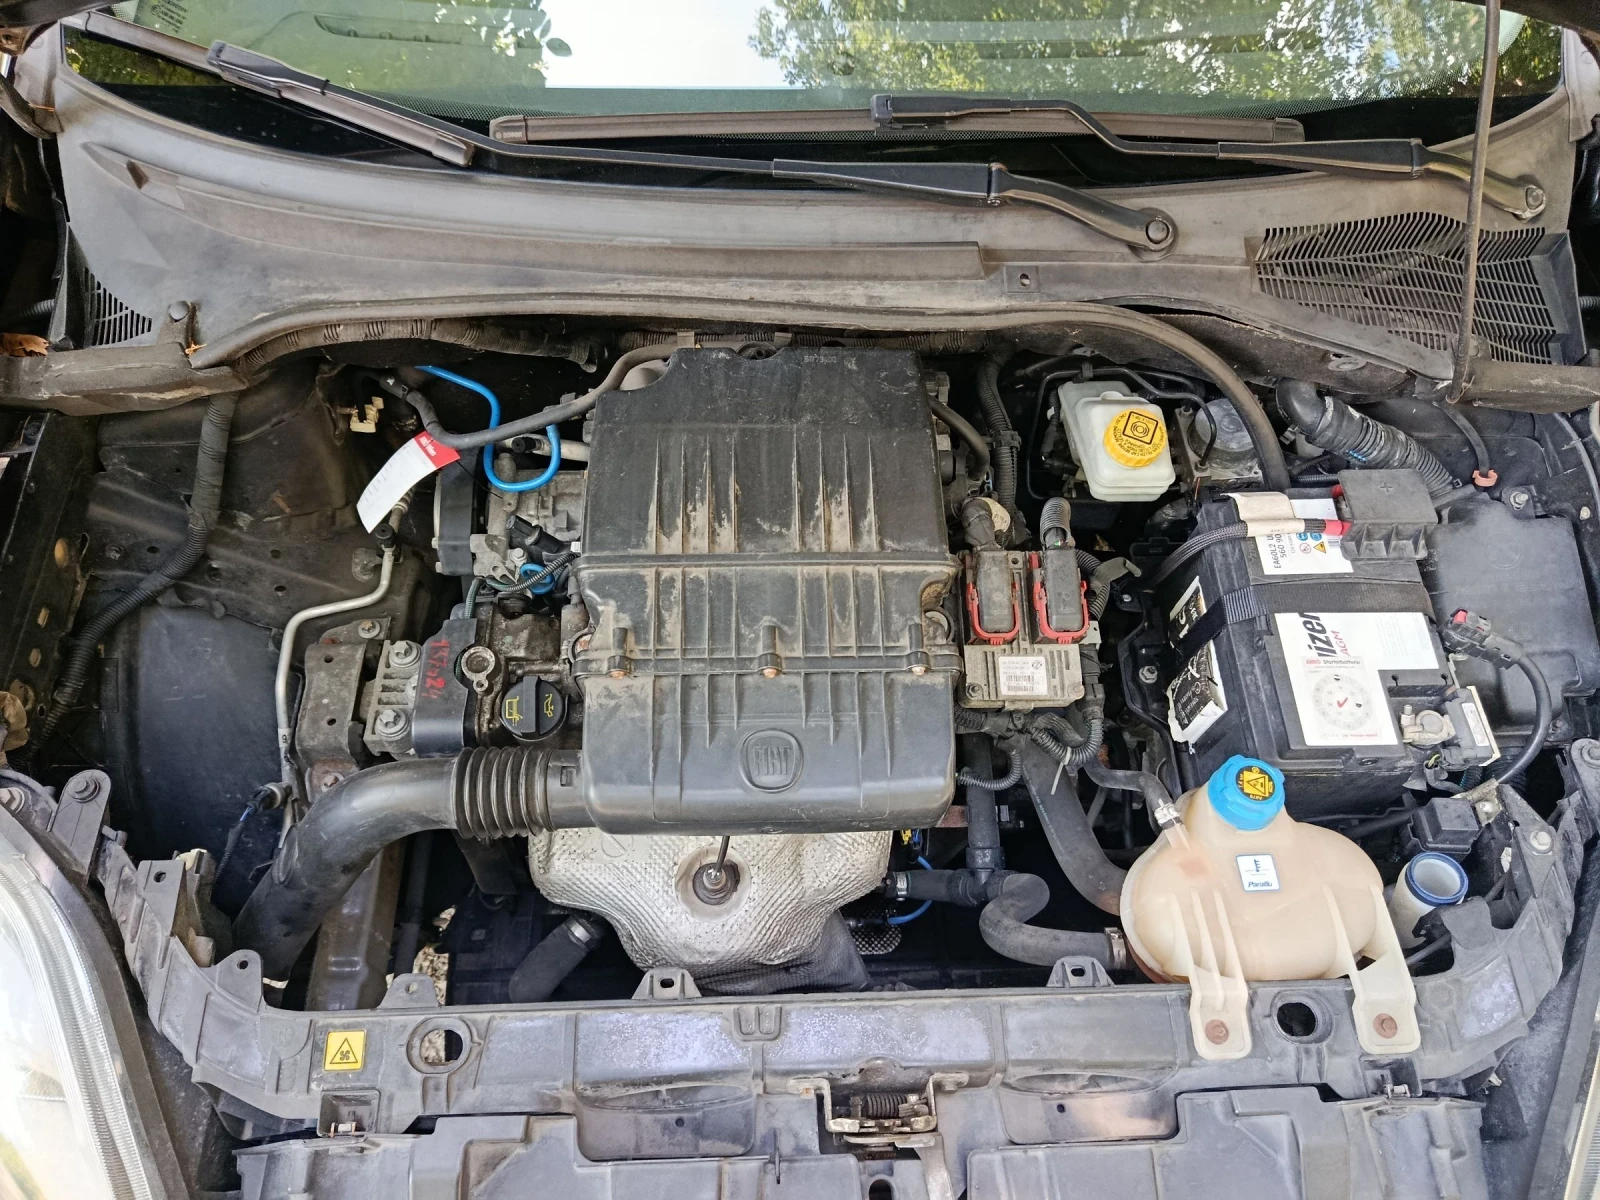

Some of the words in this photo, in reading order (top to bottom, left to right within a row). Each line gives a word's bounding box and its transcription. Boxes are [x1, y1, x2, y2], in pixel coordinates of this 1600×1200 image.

[1278, 544, 1288, 558] 560
[1330, 630, 1351, 657] AGM
[753, 746, 791, 776] FIAT
